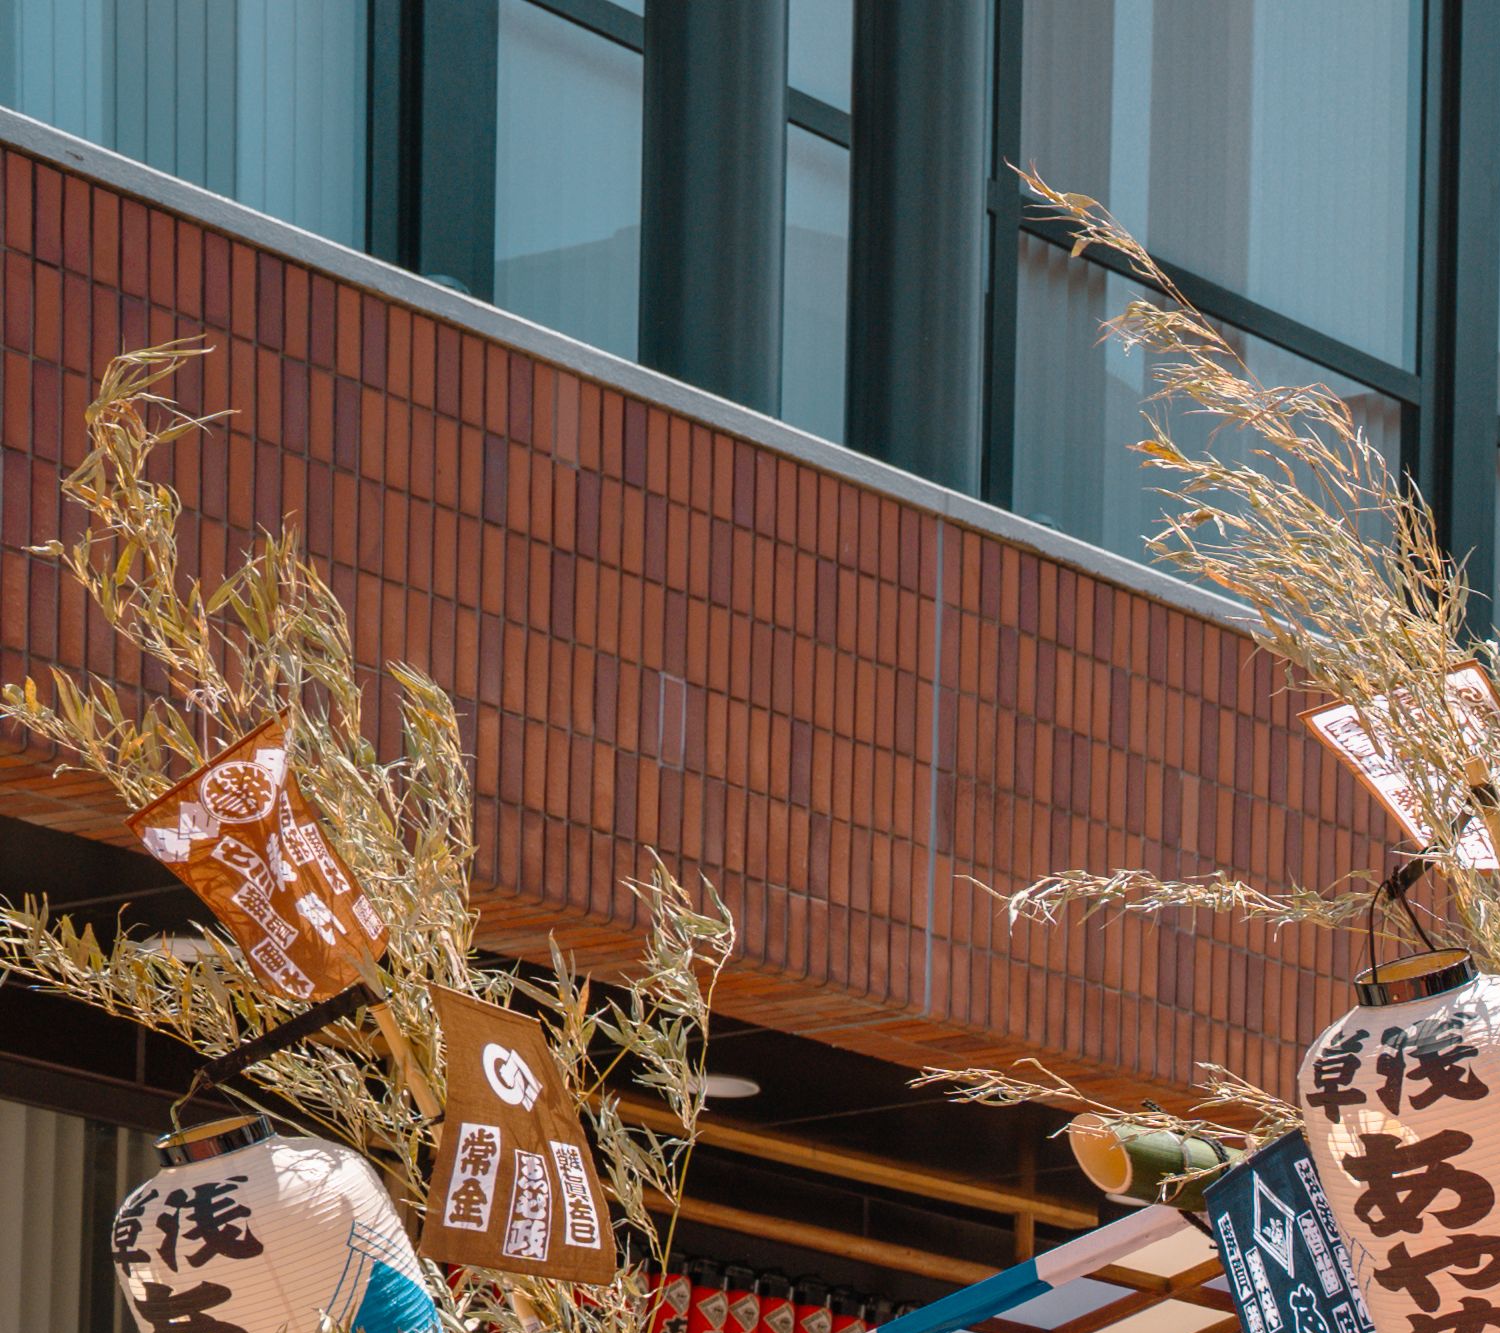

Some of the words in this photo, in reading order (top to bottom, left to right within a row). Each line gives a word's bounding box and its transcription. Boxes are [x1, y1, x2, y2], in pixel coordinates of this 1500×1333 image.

[1306, 1011, 1490, 1123] 浅草
[111, 1174, 264, 1277] 浅草
[449, 1128, 498, 1229] 常金
